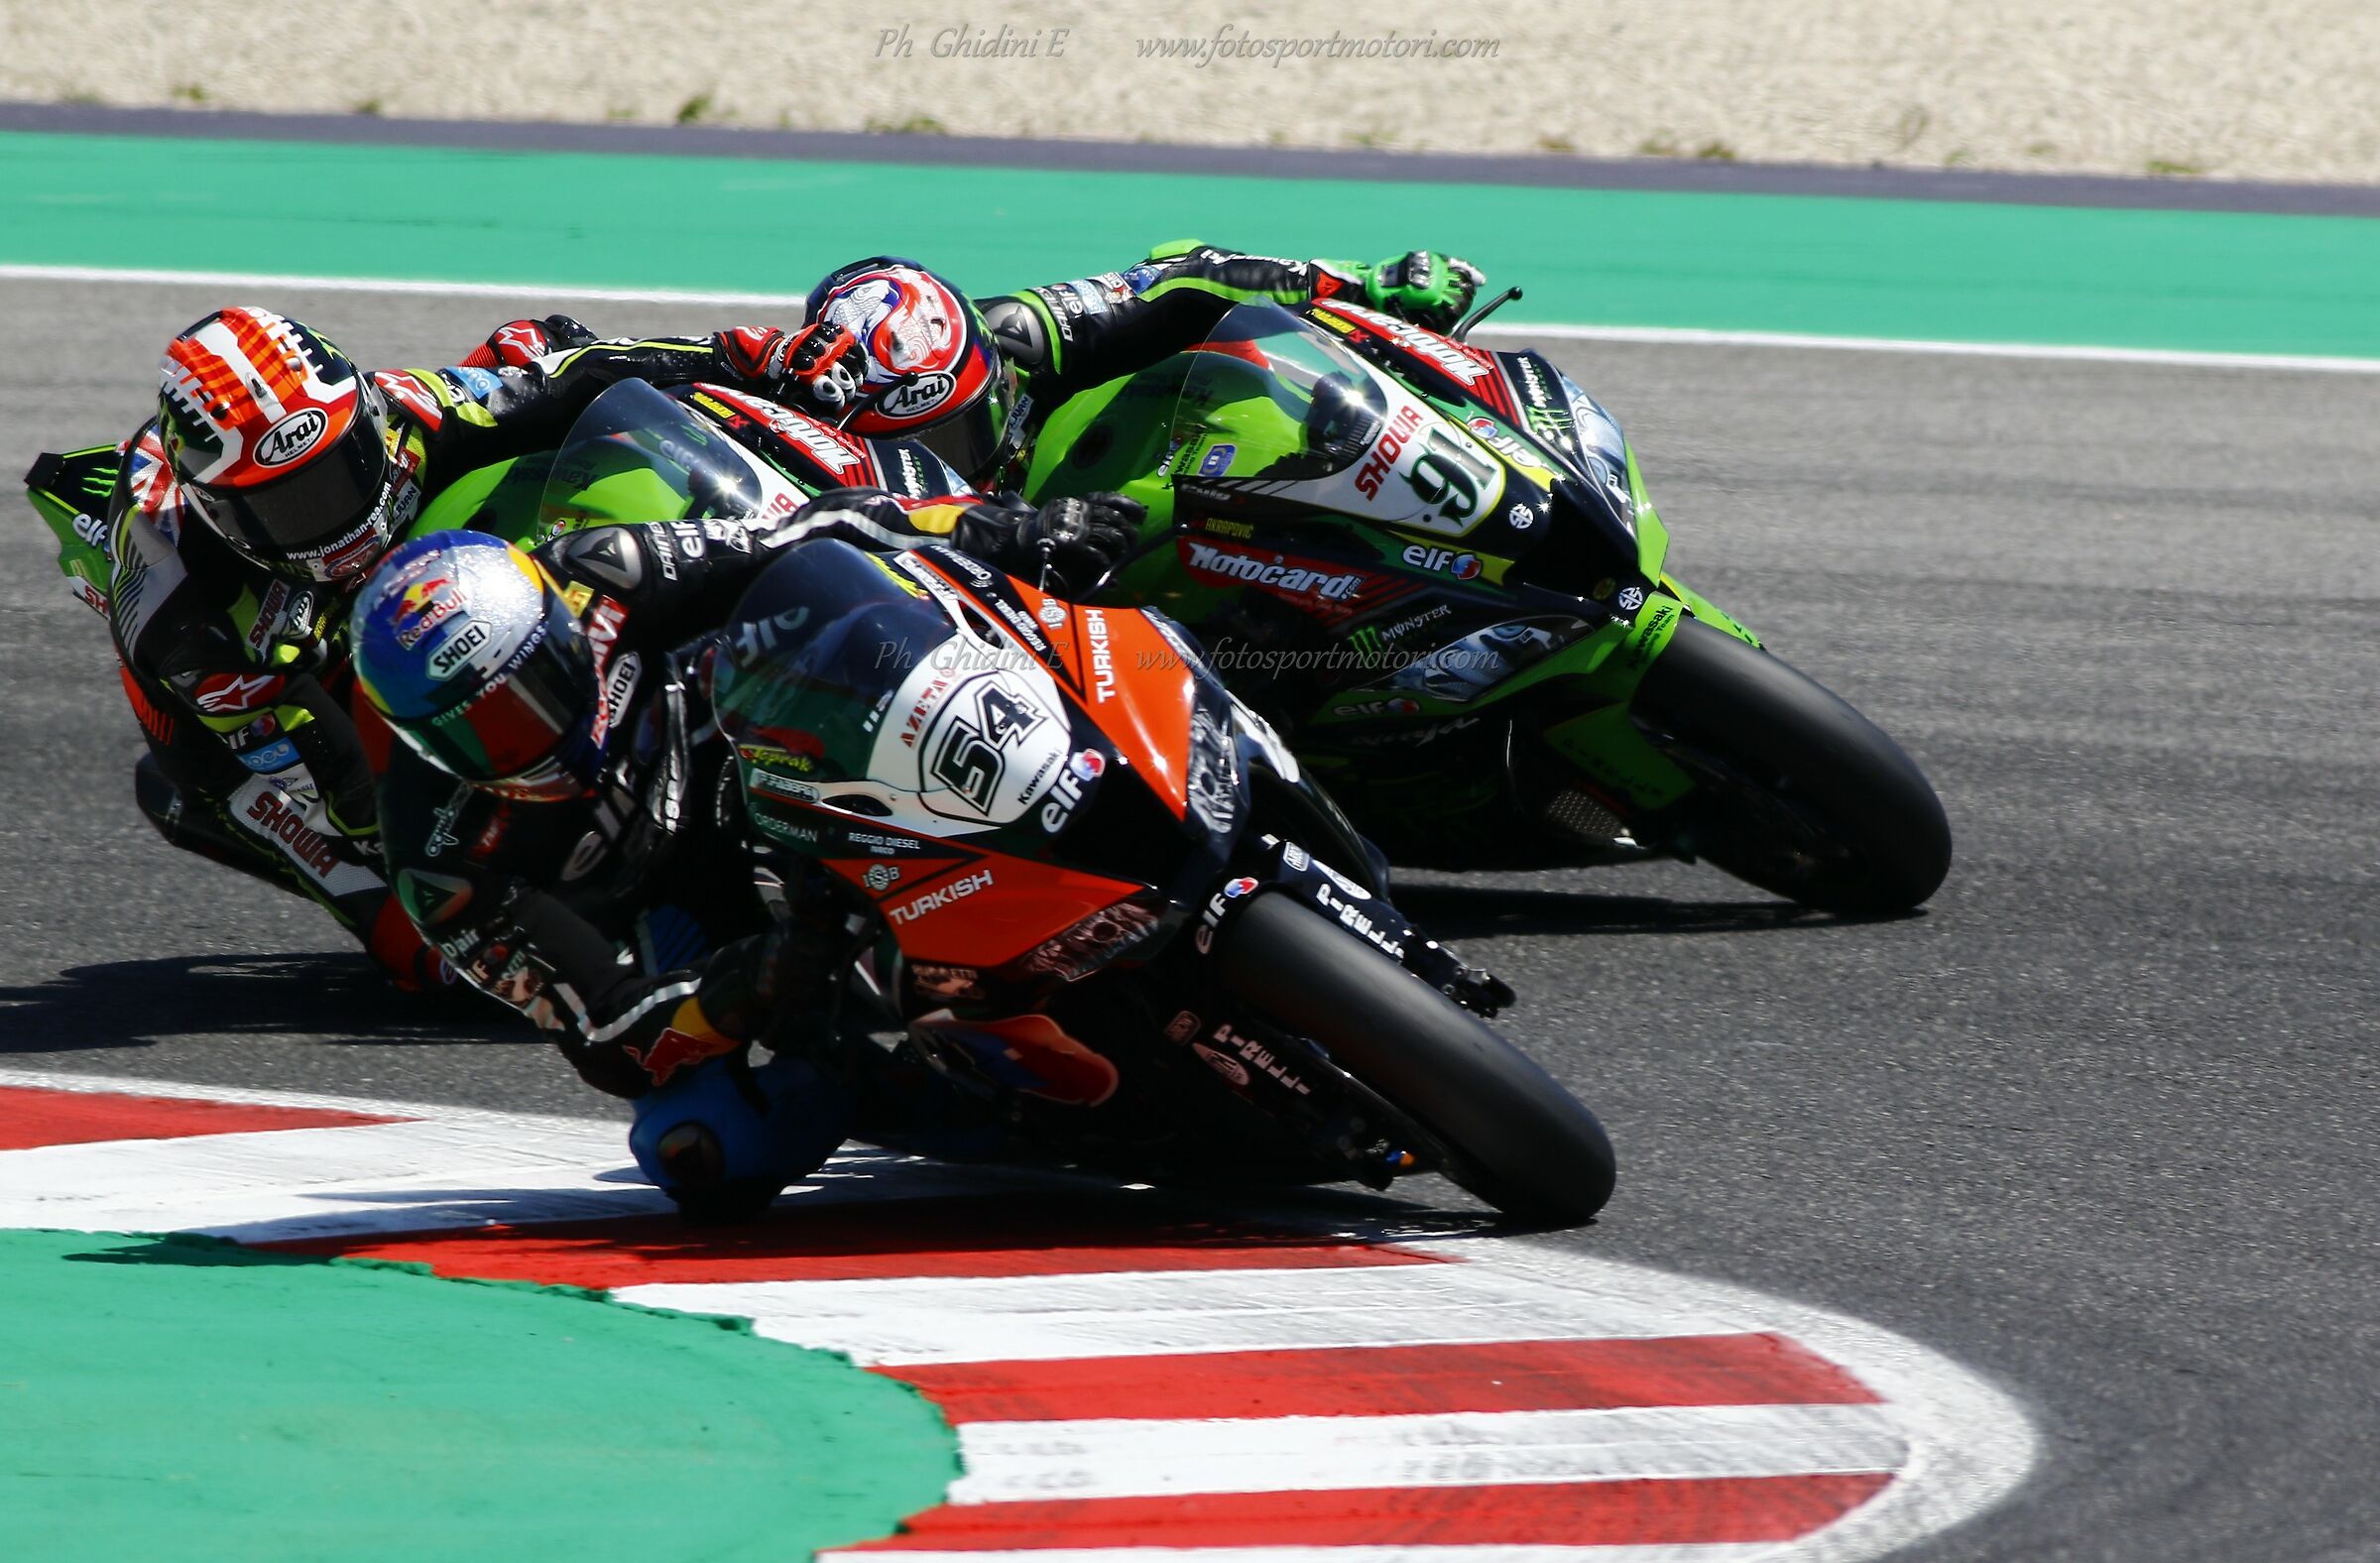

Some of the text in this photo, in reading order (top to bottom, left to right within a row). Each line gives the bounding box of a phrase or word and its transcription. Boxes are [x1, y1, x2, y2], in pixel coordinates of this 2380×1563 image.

[884, 374, 944, 416] Arai
[263, 412, 318, 464] Arai
[1355, 406, 1423, 501] SHOWA
[1398, 426, 1496, 529] 91
[287, 481, 393, 560] www.jonathan-rea.com
[399, 588, 468, 651] Red Bull
[432, 625, 487, 674] SHOEI
[1380, 605, 1452, 641] MONSTER
[432, 624, 547, 727] GIVES YOU WINGS
[1085, 609, 1116, 704] TURKISH
[227, 725, 250, 750] lf
[930, 679, 1048, 817] 54
[1017, 748, 1064, 805] Kawasaki
[247, 791, 341, 879] SHOWA
[848, 832, 921, 850] REGGIO DIESEL
[890, 869, 995, 925] TURKISH
